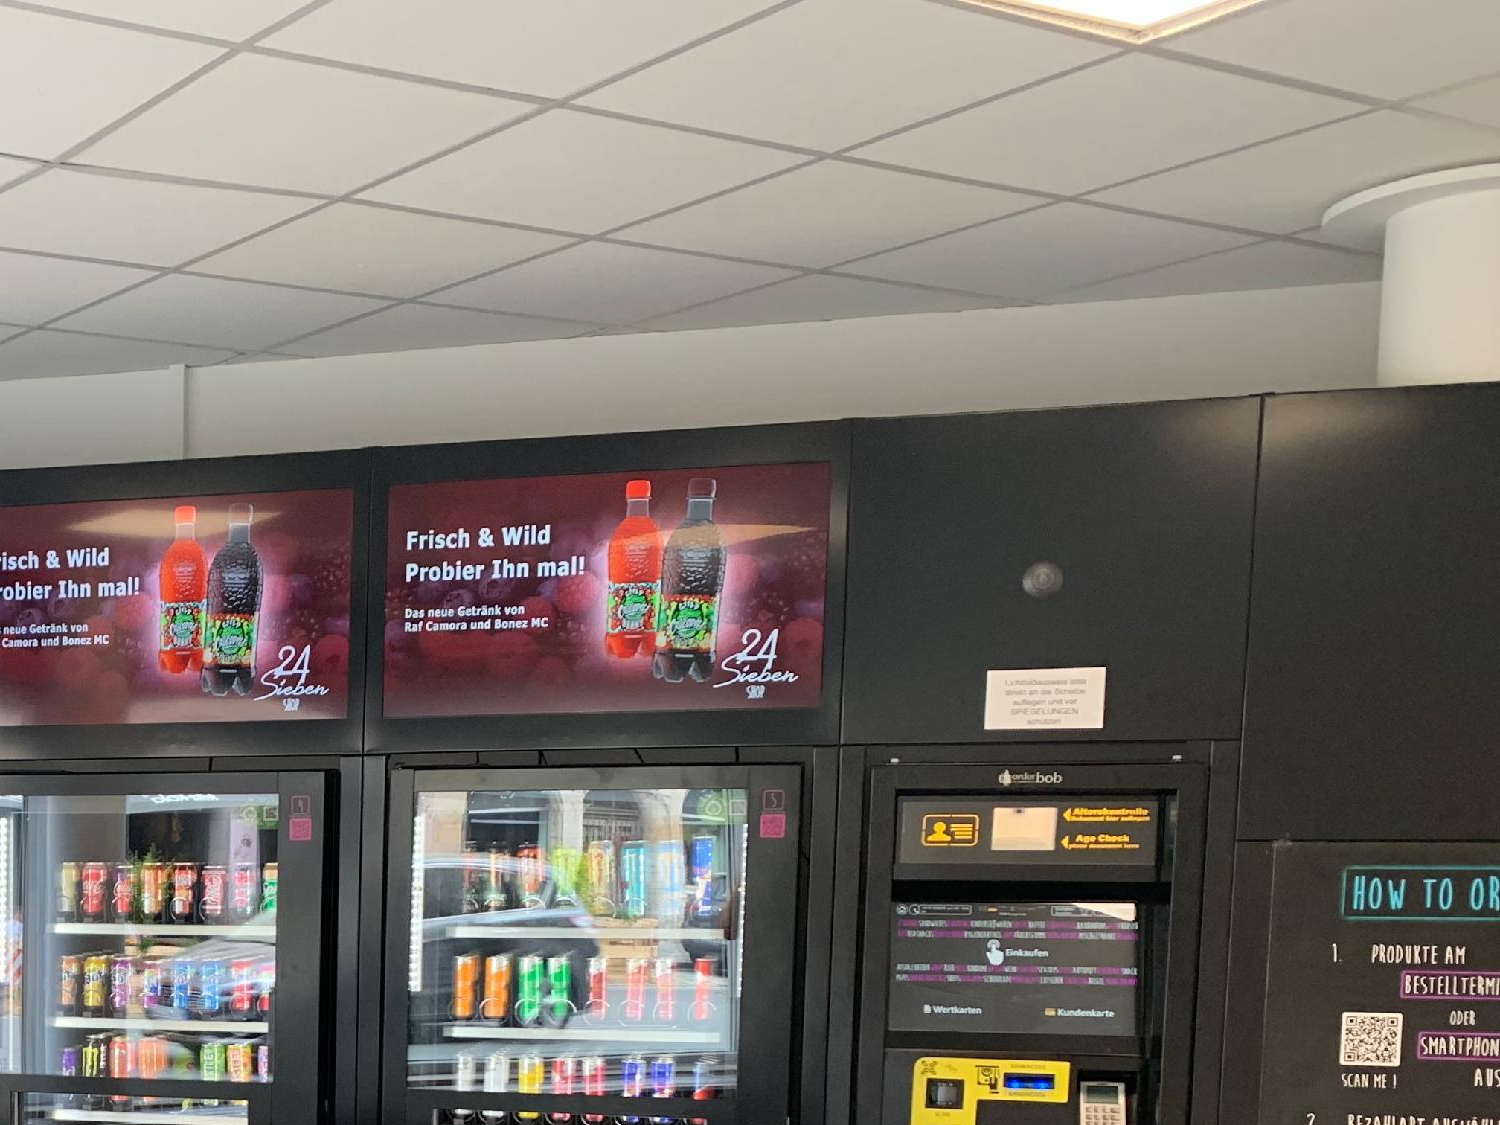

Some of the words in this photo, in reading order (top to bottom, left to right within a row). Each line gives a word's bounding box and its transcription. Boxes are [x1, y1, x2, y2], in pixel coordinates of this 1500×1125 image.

[407, 528, 469, 550] Frisch
[478, 528, 494, 547] &
[502, 525, 550, 545] Wild
[46, 551, 60, 568] &
[66, 547, 109, 567] Wild
[406, 560, 484, 582] Probier
[491, 559, 528, 579] Ihn
[537, 556, 585, 577] mal!
[59, 580, 91, 598] Ihn
[98, 577, 139, 597] mal!
[405, 609, 424, 618] Das
[428, 609, 454, 617] neue
[458, 605, 501, 616] Getränk
[504, 606, 525, 615] von
[4, 626, 27, 634] neue
[29, 624, 68, 633] Getränk
[71, 624, 88, 632] von
[405, 621, 423, 632] Raf
[426, 621, 467, 631] Camora
[471, 619, 491, 629] und
[531, 618, 548, 627] MC
[2, 638, 38, 647] Camora
[41, 636, 59, 646] und
[94, 635, 109, 644] MC
[739, 628, 779, 670] 24
[276, 645, 310, 682] 24
[713, 654, 799, 688] Sieben
[254, 670, 330, 700] Sieben
[1076, 834, 1096, 843] Age
[1097, 834, 1130, 842] Check
[1352, 875, 1406, 911] HOW
[1423, 878, 1454, 910] TO
[1005, 947, 1049, 958] Einkaufen
[1371, 944, 1438, 965] PRODUKTE
[1445, 946, 1466, 965] AM
[933, 1005, 982, 1015] Wertkarten
[1057, 1008, 1115, 1018] Kundenkarte
[1450, 1010, 1476, 1026] ODER
[1341, 1073, 1369, 1088] SCAN
[1373, 1074, 1387, 1089] ME
